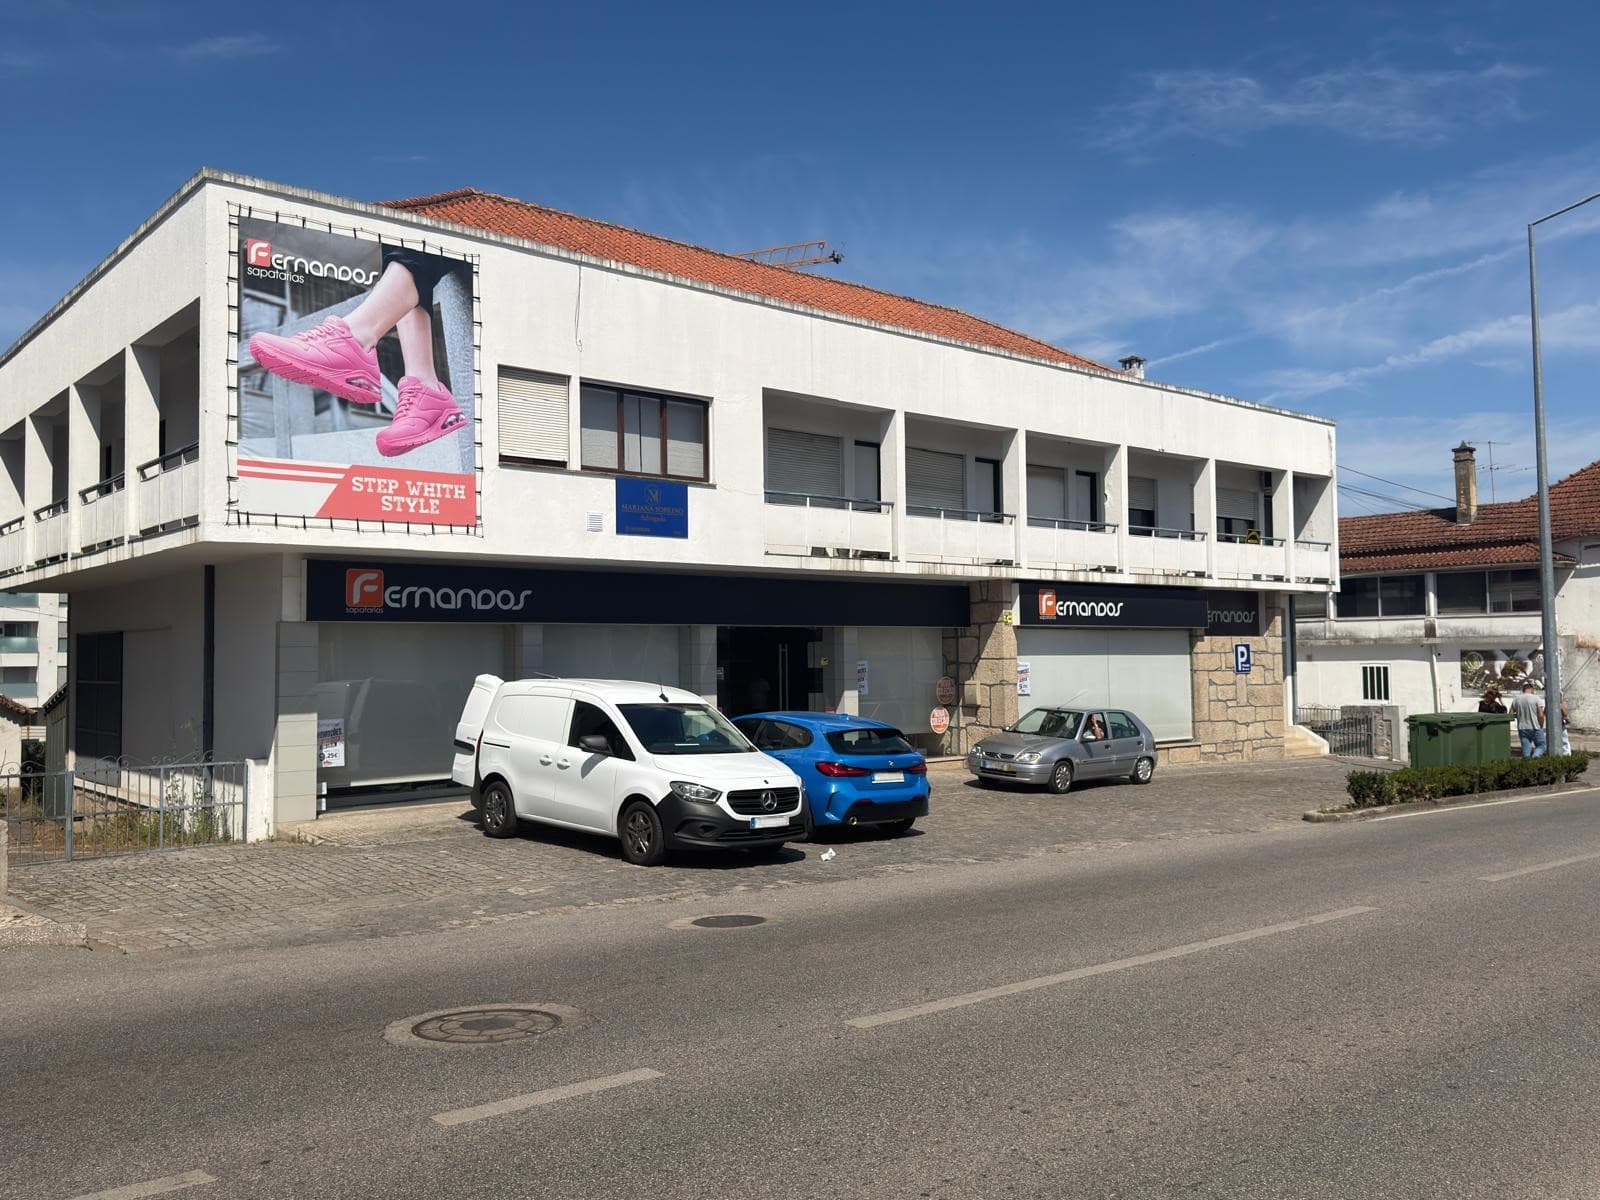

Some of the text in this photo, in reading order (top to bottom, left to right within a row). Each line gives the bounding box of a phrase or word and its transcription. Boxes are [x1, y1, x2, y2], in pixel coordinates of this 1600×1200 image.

[246, 266, 304, 283] sapatarias
[351, 476, 466, 499] STEP WHITH
[381, 495, 440, 514] STYLE
[1208, 610, 1256, 623] ernandos
[1236, 645, 1248, 671] P
